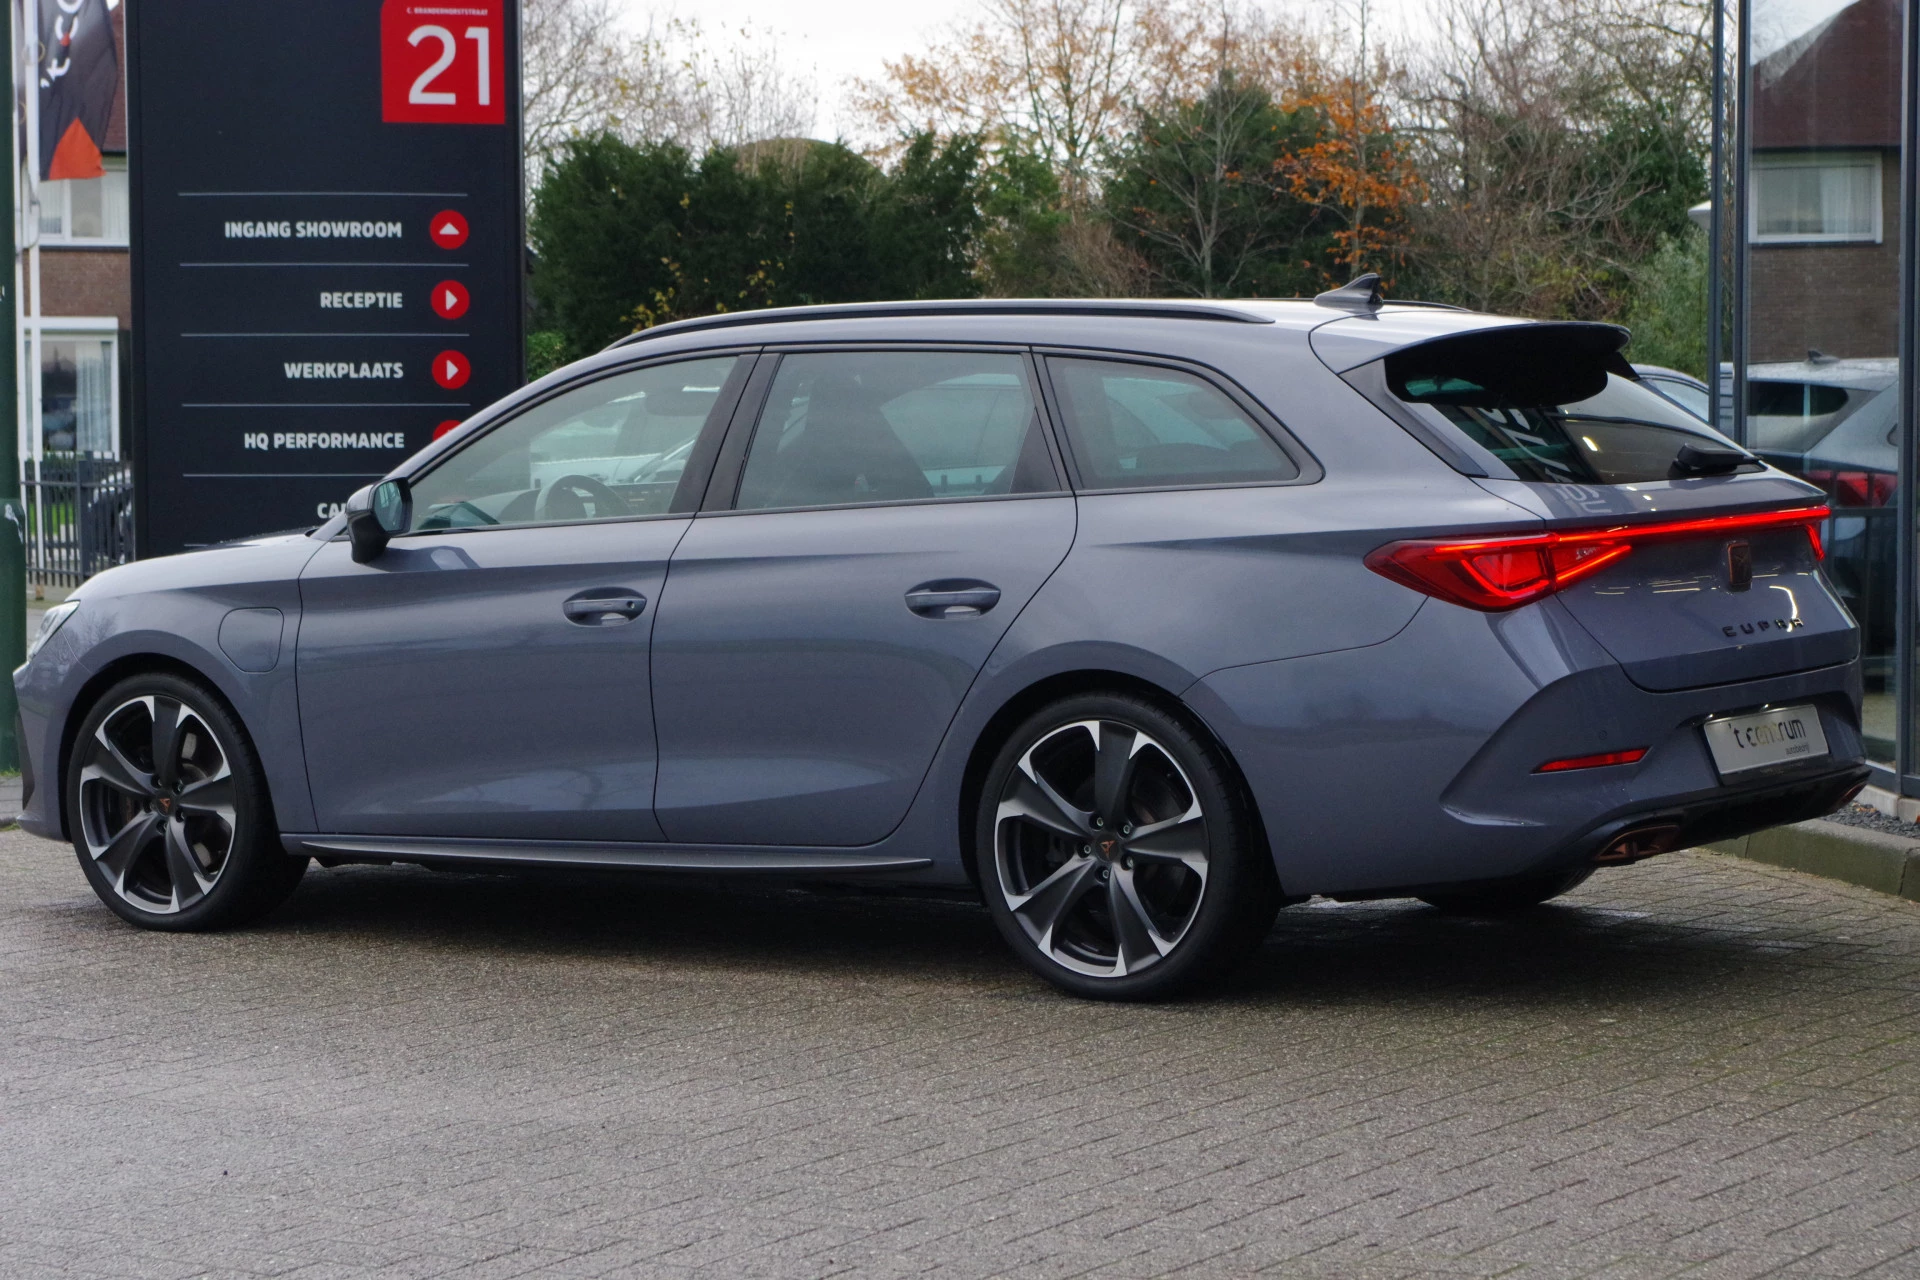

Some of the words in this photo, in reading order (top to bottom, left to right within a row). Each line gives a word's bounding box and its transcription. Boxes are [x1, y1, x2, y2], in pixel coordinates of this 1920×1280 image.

[407, 24, 490, 105] 21
[224, 221, 291, 238] INGANG
[296, 221, 402, 238] SHOWROOM
[320, 292, 403, 308] RECEPTIE
[284, 362, 404, 379] WERKPLAATS
[244, 432, 269, 450] HQ
[273, 432, 405, 449] PERFORMANCE
[1722, 617, 1804, 638] CUPRA
